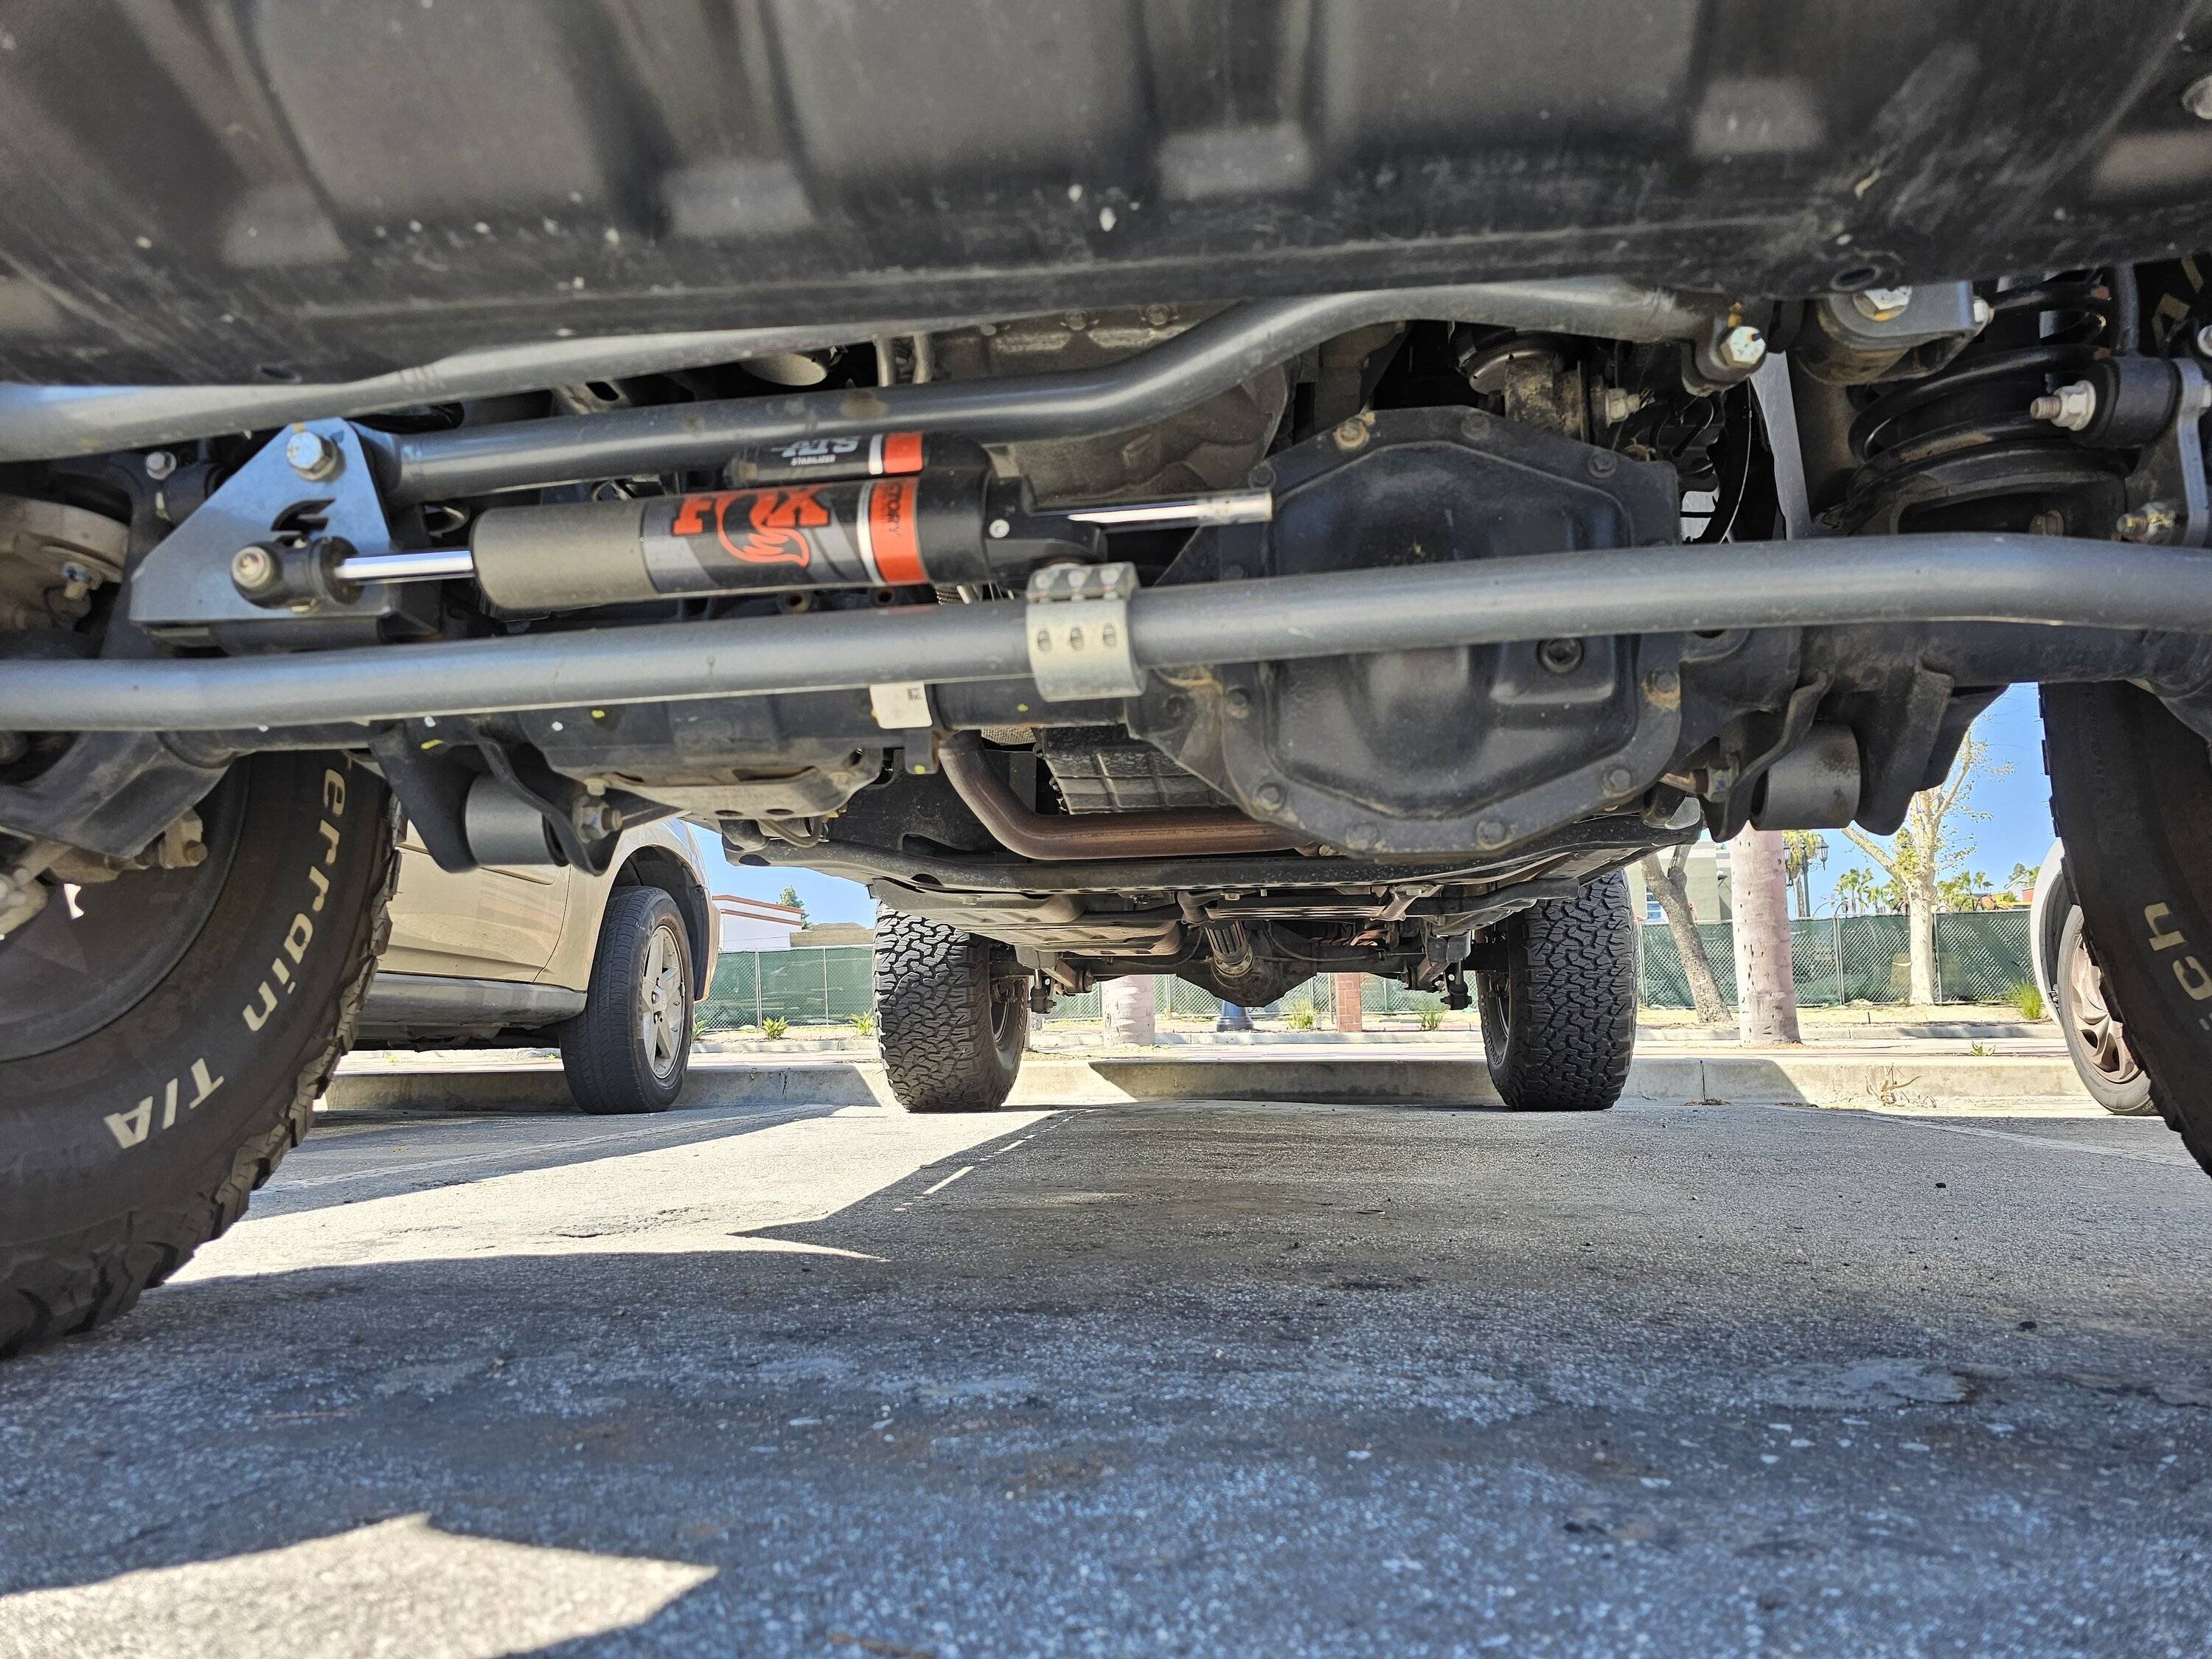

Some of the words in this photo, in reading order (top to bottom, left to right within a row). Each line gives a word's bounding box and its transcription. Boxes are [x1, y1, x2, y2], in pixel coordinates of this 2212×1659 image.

[242, 759, 349, 1032] errain
[2143, 902, 2212, 1031] ch
[103, 1057, 224, 1149] T/A
